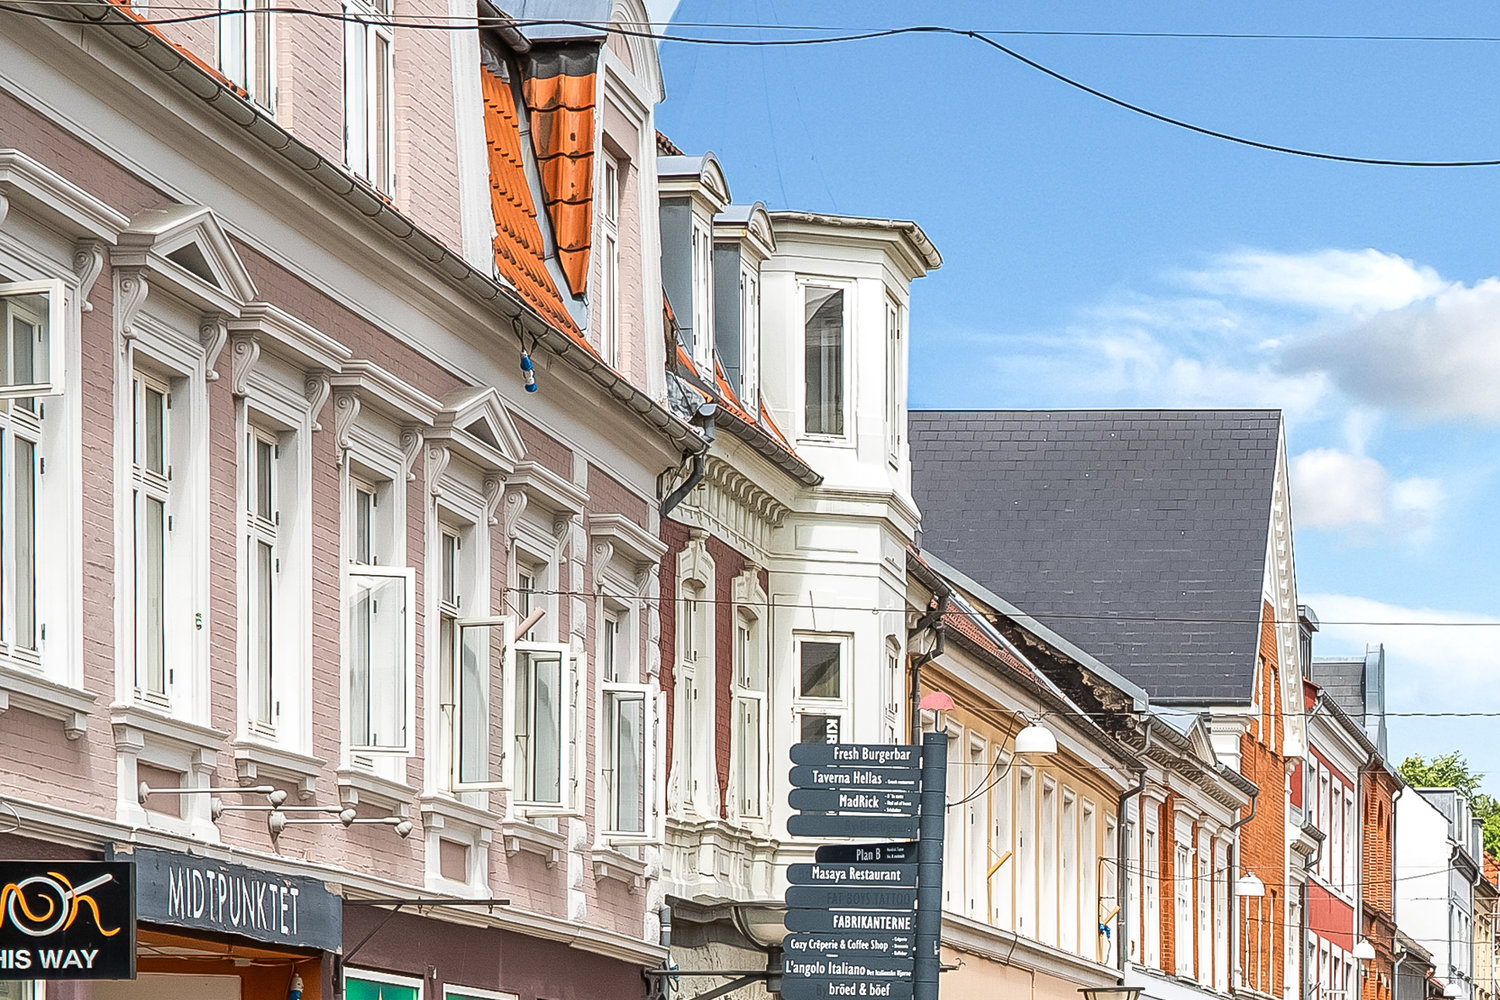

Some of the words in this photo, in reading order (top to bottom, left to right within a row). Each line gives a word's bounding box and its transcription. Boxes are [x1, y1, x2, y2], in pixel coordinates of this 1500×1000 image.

[834, 747, 859, 760] Fresh
[862, 747, 911, 764] Burgerbar
[812, 770, 850, 783] Taverna
[853, 771, 882, 784] Hellas
[840, 794, 880, 808] MadRick
[856, 849, 873, 861] Plan
[876, 848, 881, 860] B
[812, 866, 846, 883] Masaya
[850, 867, 901, 880] Restaurant
[168, 866, 299, 936] MIDTPUNKTET
[833, 915, 911, 930] FABRIKANTERNE
[790, 938, 808, 952] Cozy
[840, 940, 846, 949] &
[847, 940, 869, 950] Coffee
[870, 940, 888, 952] Shop
[38, 950, 99, 969] WAY
[786, 960, 826, 977] L'angolo
[828, 961, 866, 976] Italiano
[859, 983, 866, 996] &
